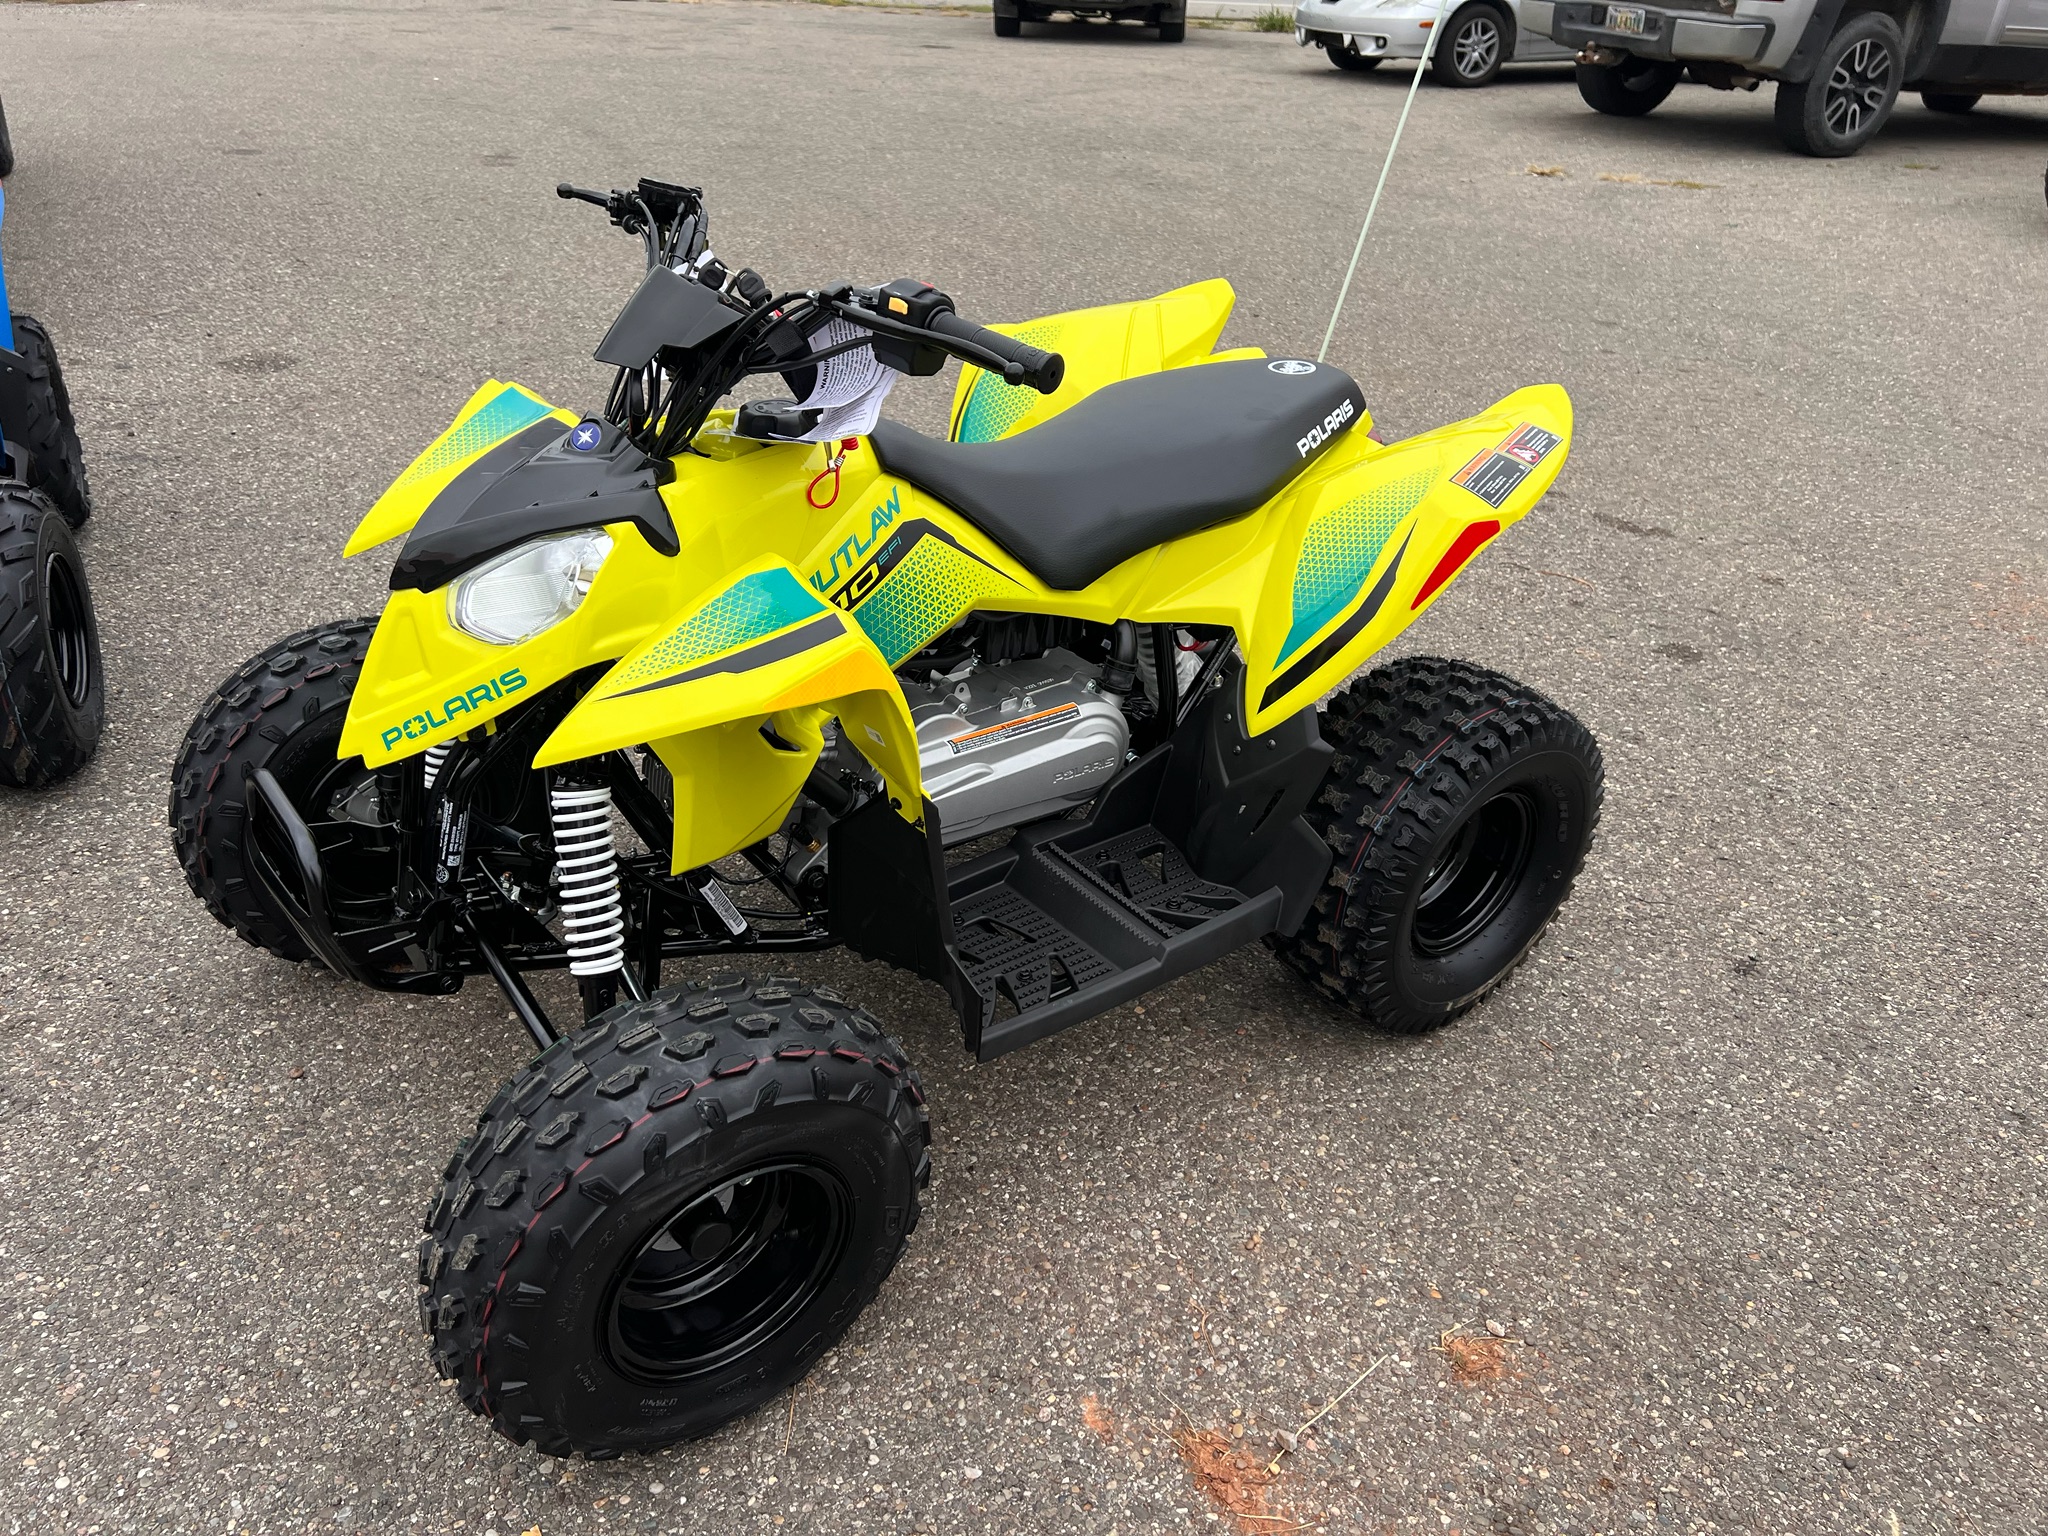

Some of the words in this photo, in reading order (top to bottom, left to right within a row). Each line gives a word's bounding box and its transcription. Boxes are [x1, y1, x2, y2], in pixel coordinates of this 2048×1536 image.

[820, 359, 830, 389] WARNI
[1296, 398, 1354, 458] POLARIS
[809, 485, 901, 593] UTLAW
[878, 536, 902, 566] EFI
[381, 668, 527, 751] POLARIS
[1053, 757, 1115, 784] POLARIS
